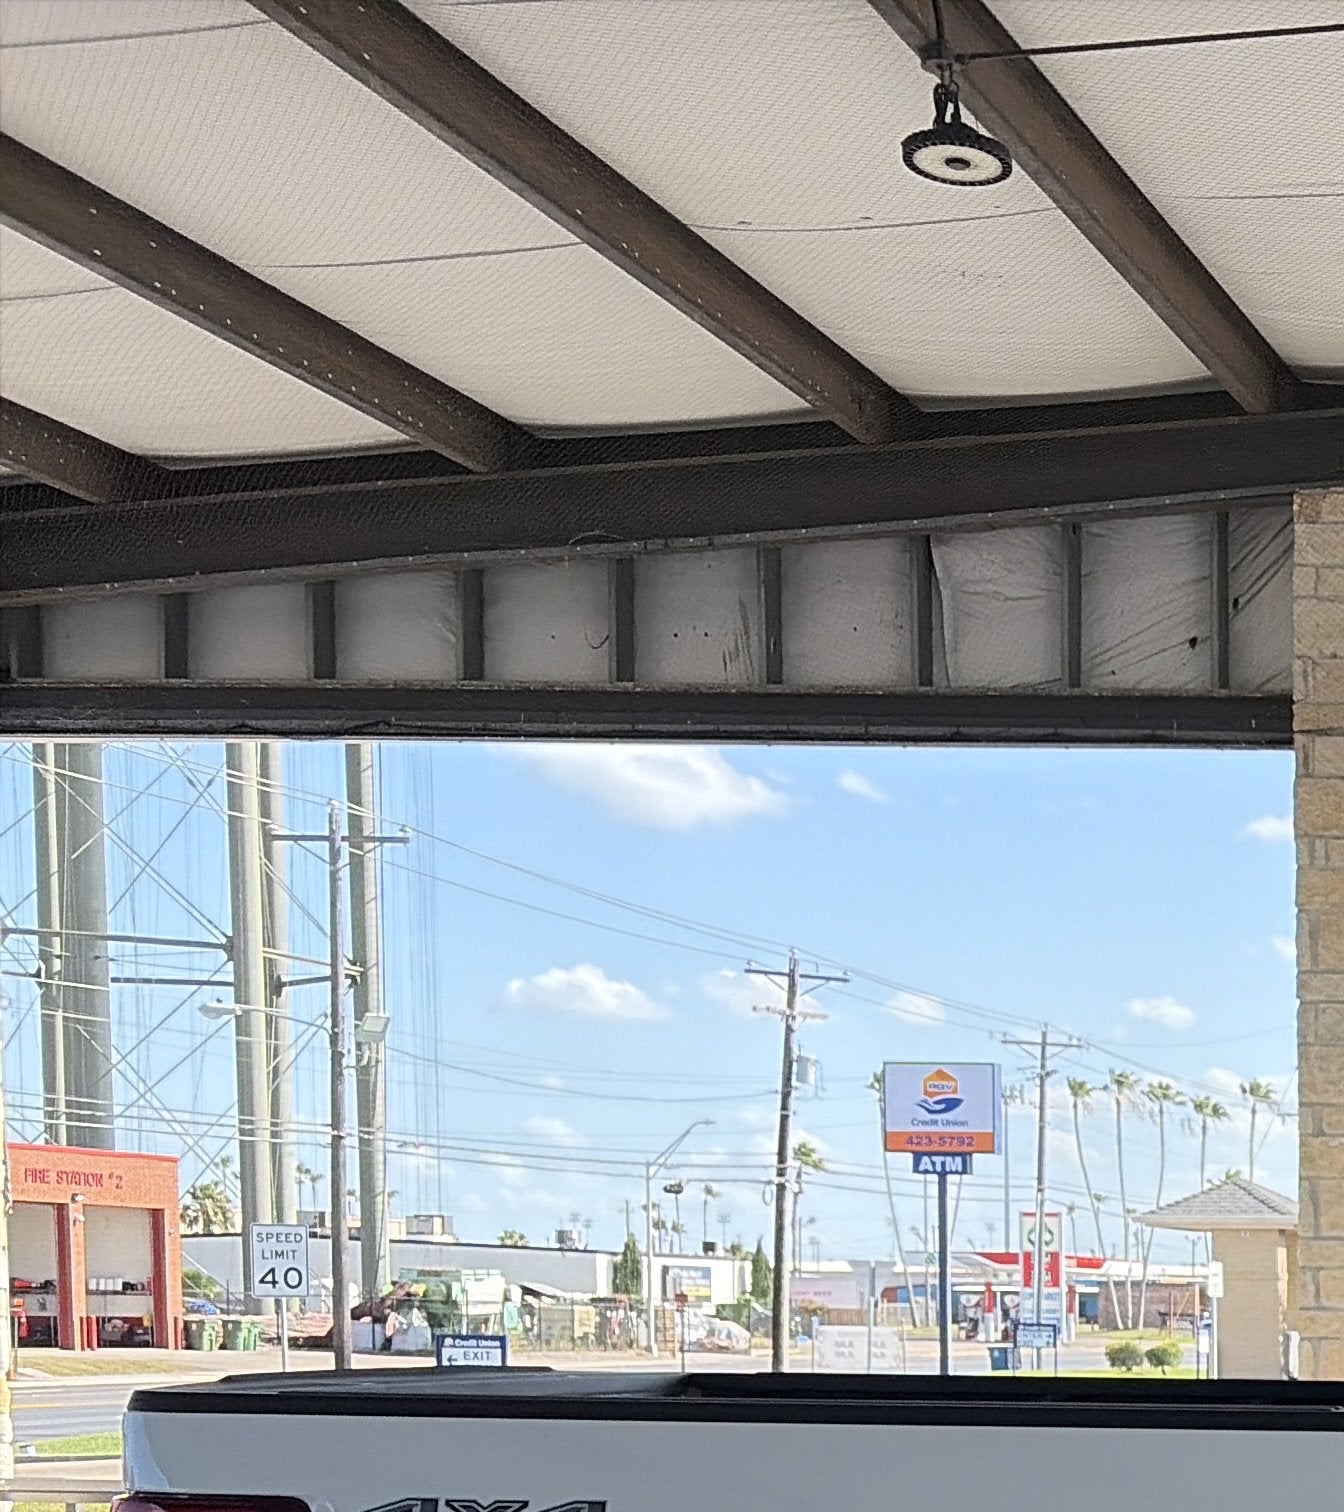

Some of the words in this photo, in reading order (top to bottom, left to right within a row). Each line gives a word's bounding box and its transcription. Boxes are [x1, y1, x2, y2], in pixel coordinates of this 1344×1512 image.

[910, 1118, 939, 1127] Credit
[941, 1119, 968, 1127] Union
[918, 1156, 963, 1172] ATM
[24, 1167, 51, 1185] FIRE
[56, 1169, 104, 1188] STATION
[256, 1232, 303, 1243] SPEED
[261, 1249, 298, 1260] LIMIT
[258, 1266, 303, 1290] 40
[454, 1338, 477, 1347] Credit
[478, 1338, 501, 1347] Union
[463, 1350, 492, 1361] EXIT
